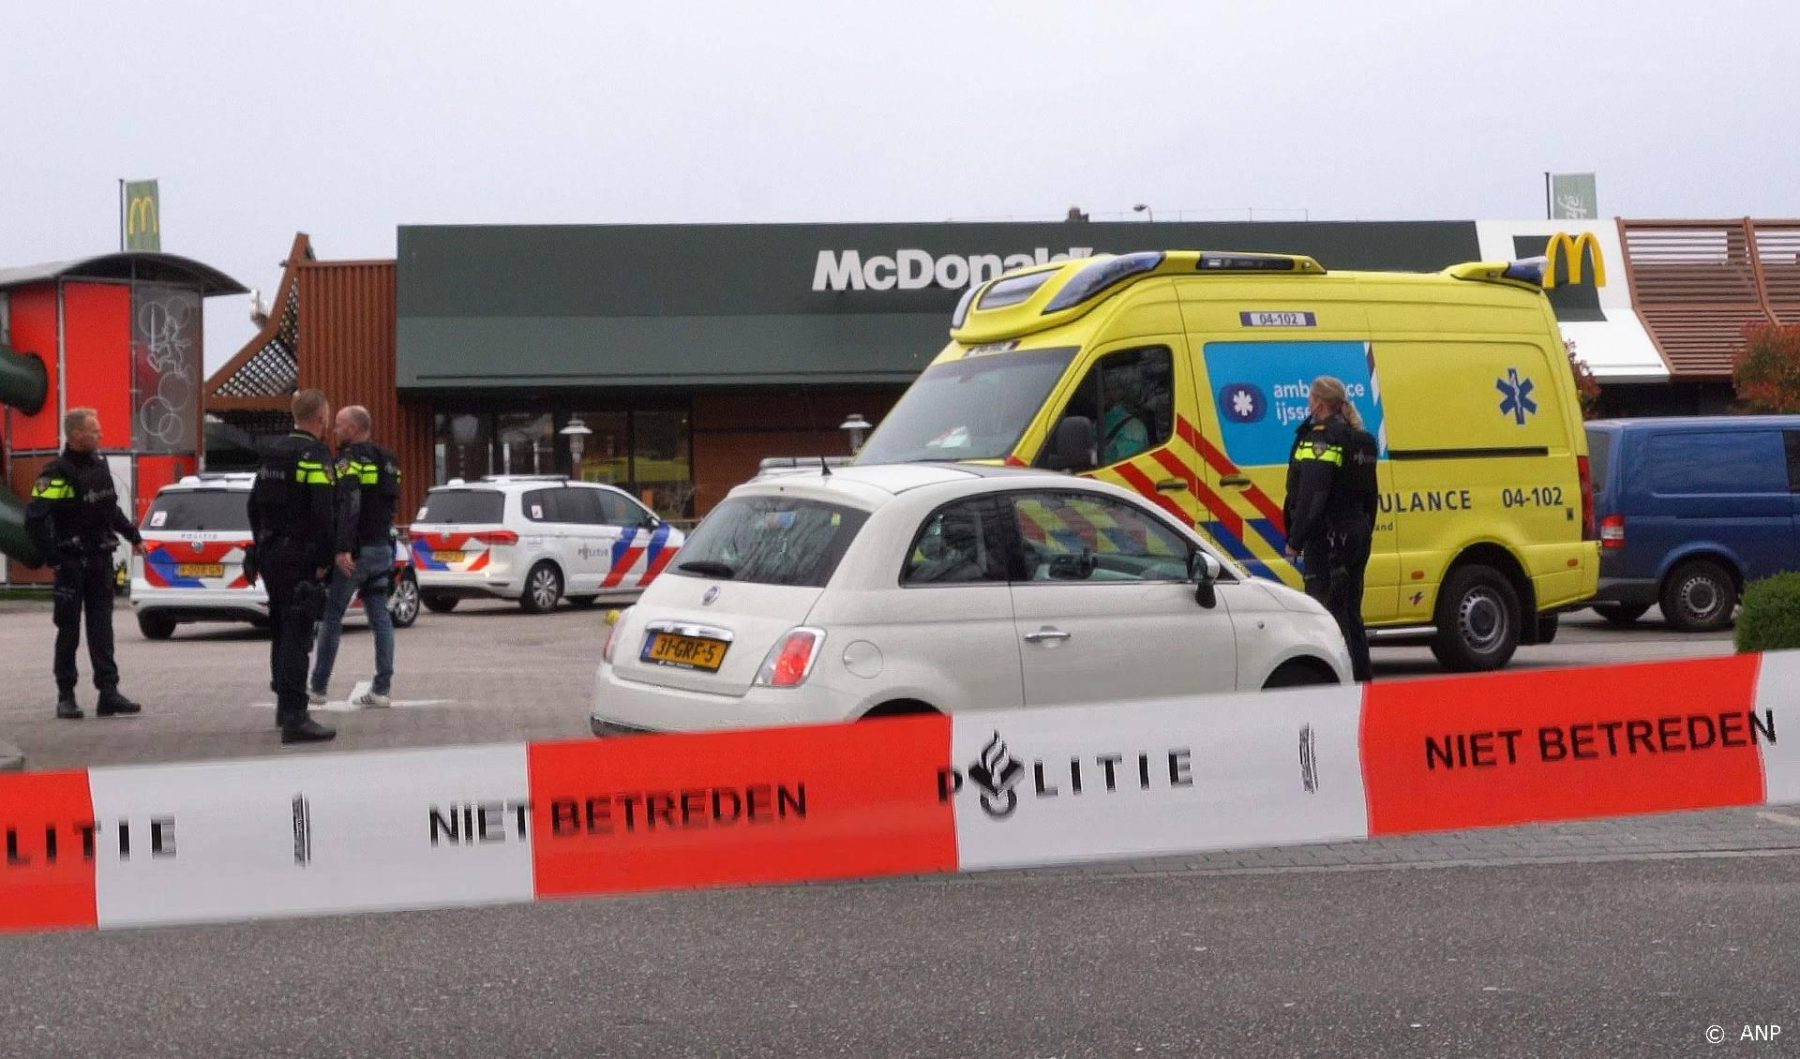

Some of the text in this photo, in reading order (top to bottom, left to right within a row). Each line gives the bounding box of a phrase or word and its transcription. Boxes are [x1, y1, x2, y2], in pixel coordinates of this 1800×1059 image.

[811, 247, 1094, 291] McDon
[1259, 313, 1299, 326] 04-102
[1273, 379, 1365, 398] ambce
[1378, 486, 1563, 513] ULANCE 04-102
[656, 636, 716, 663] 31-GRF-5
[6, 813, 177, 866] LITIE
[428, 797, 533, 849] NIET
[550, 782, 807, 840] BETREDEN
[1425, 727, 1523, 772] NIET
[1538, 707, 1777, 764] BETREDEN
